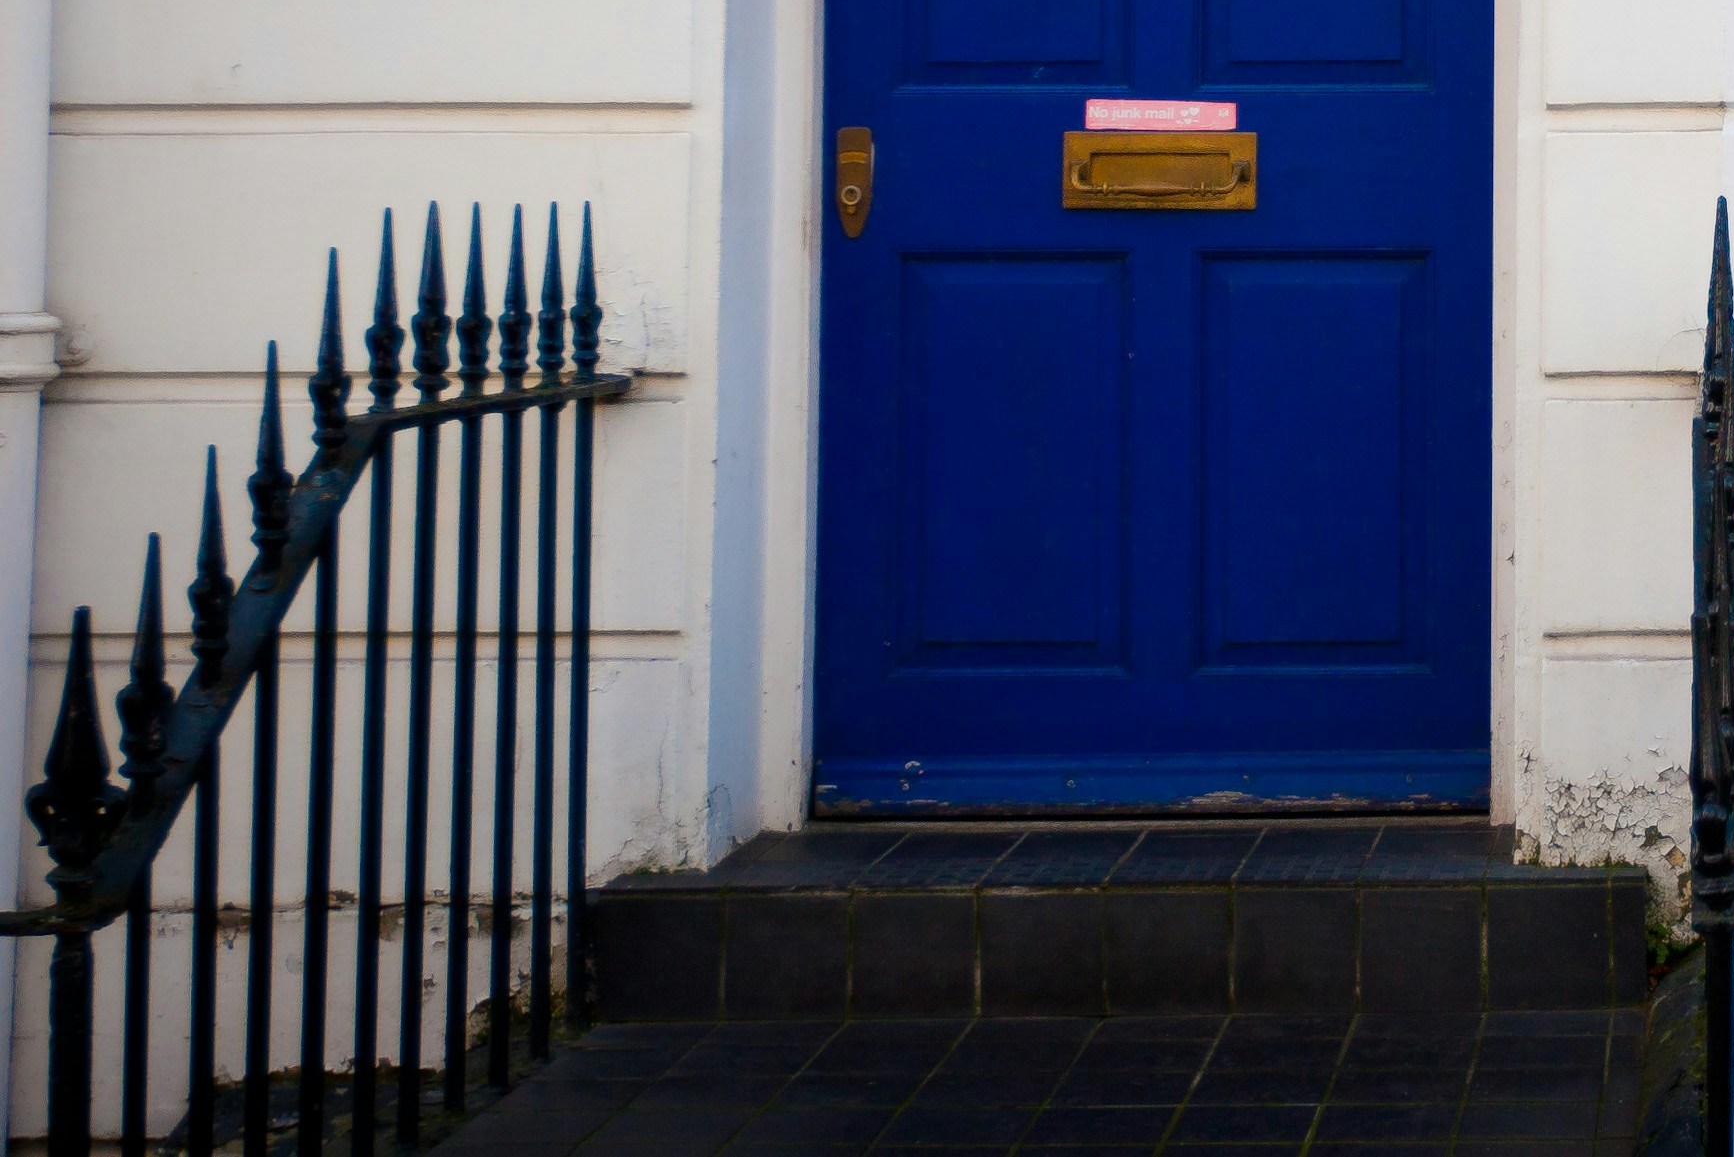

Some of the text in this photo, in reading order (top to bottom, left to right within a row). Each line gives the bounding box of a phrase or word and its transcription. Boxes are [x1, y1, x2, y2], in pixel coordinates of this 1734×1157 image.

[1088, 106, 1175, 121] No junk mail
